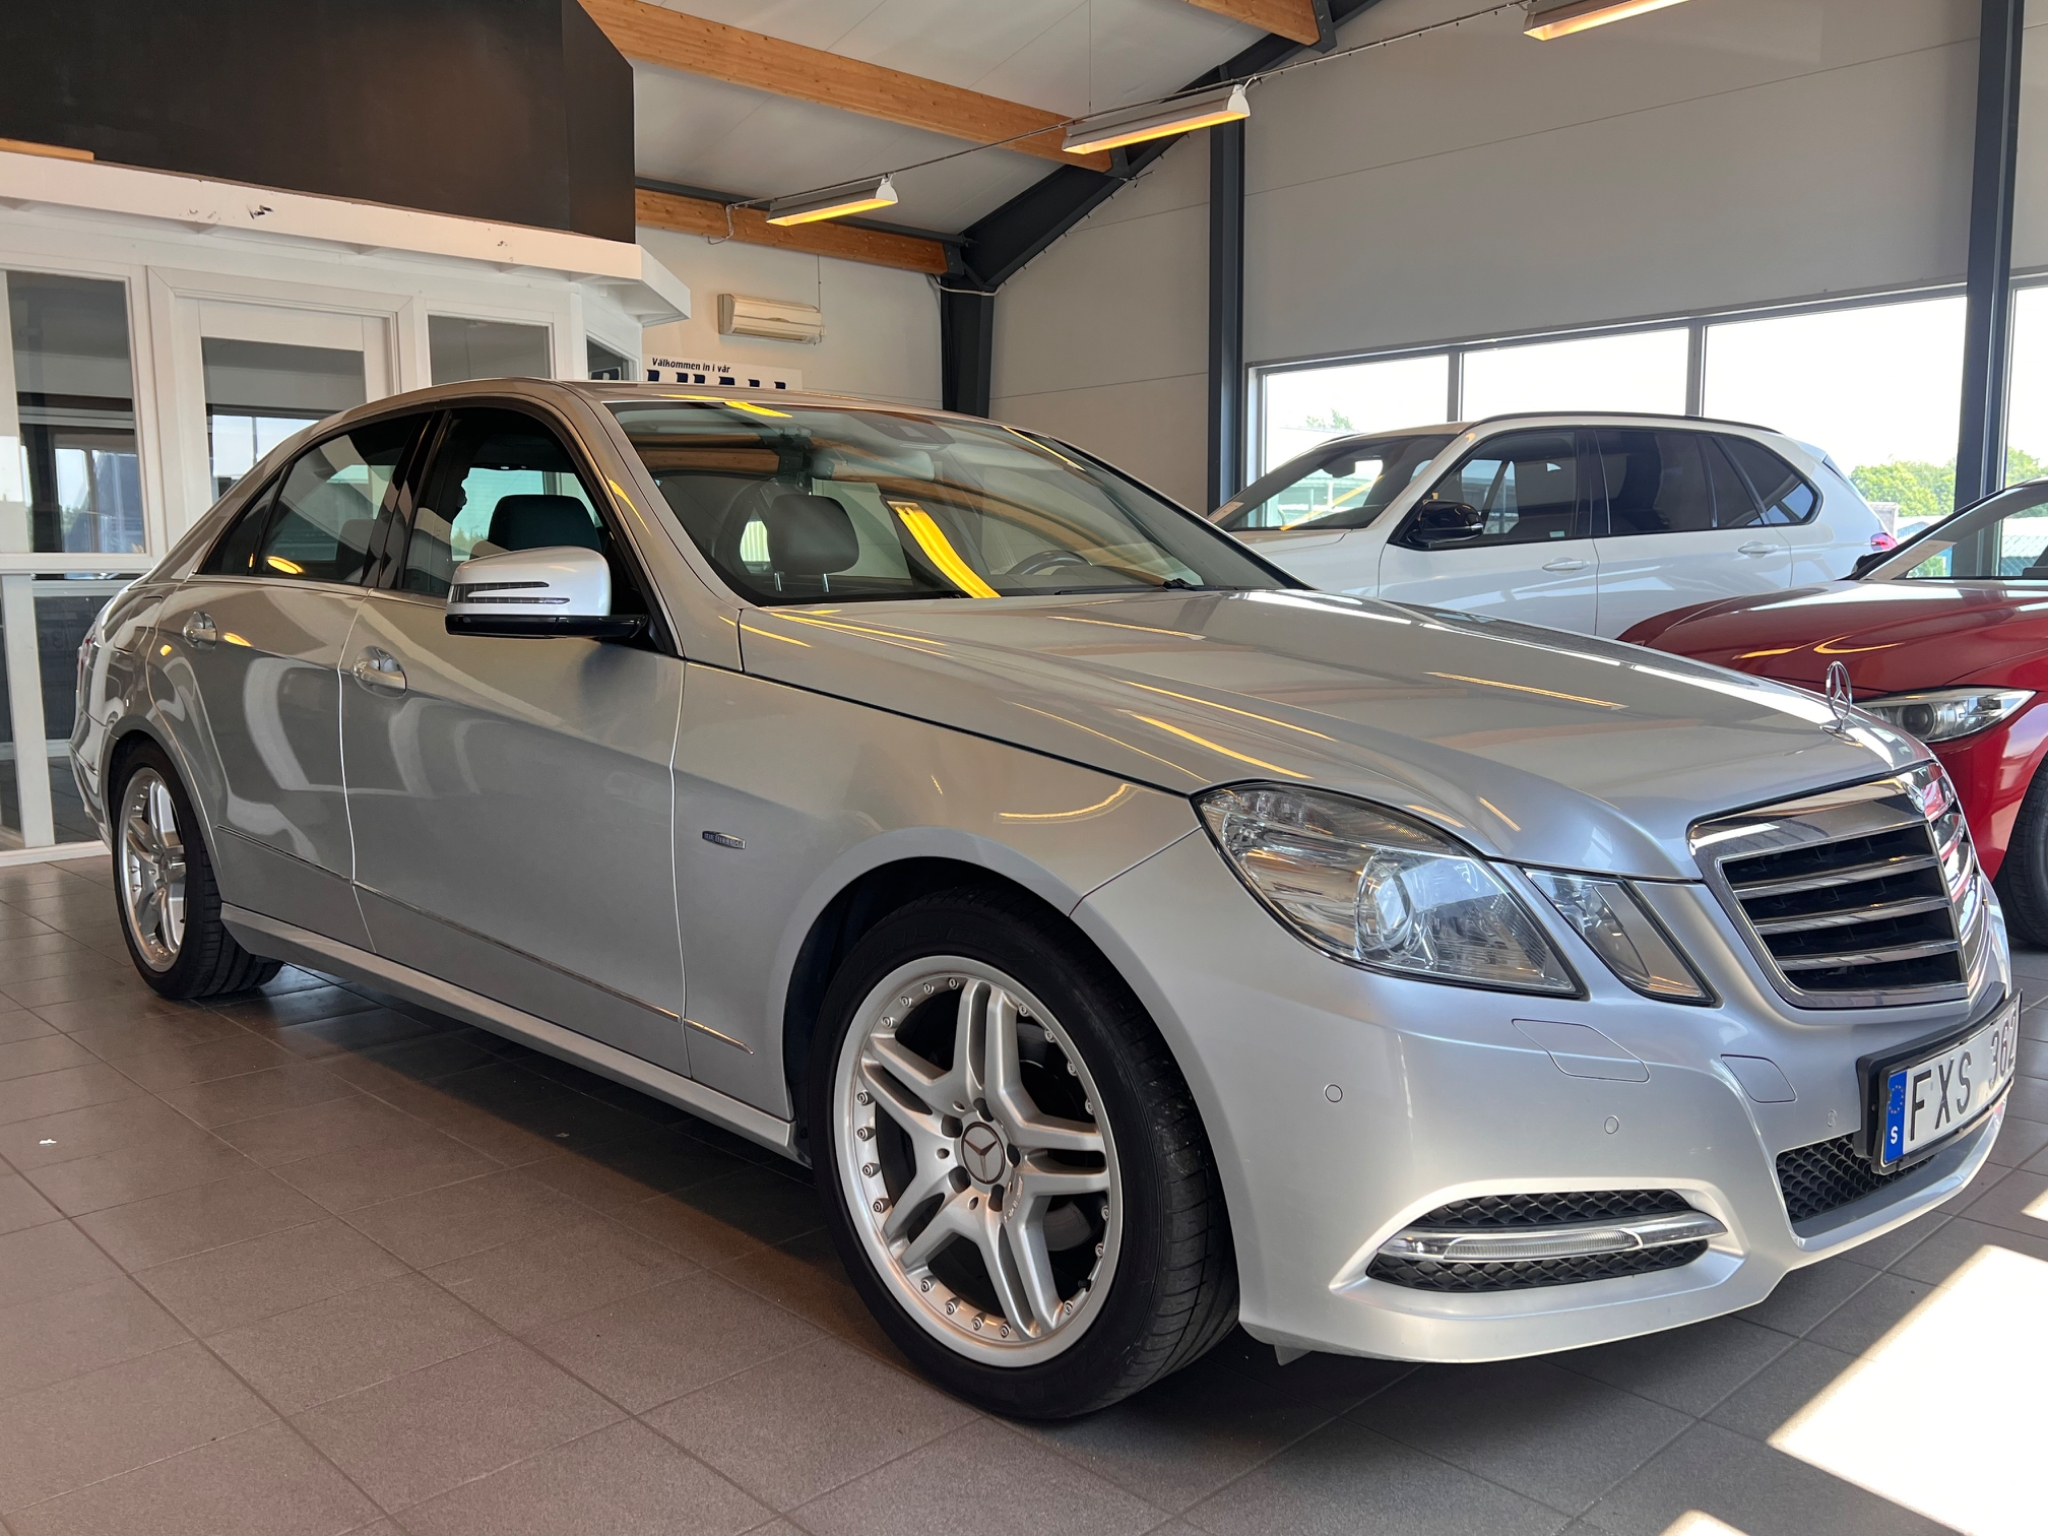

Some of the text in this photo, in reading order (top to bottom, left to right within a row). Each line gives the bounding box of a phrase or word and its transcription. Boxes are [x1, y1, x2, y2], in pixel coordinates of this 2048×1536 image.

[652, 357, 701, 371] Välkommen
[702, 362, 711, 372] in
[717, 364, 731, 374] vår
[1909, 1049, 1972, 1142] FXS
[1890, 1125, 1899, 1145] S
